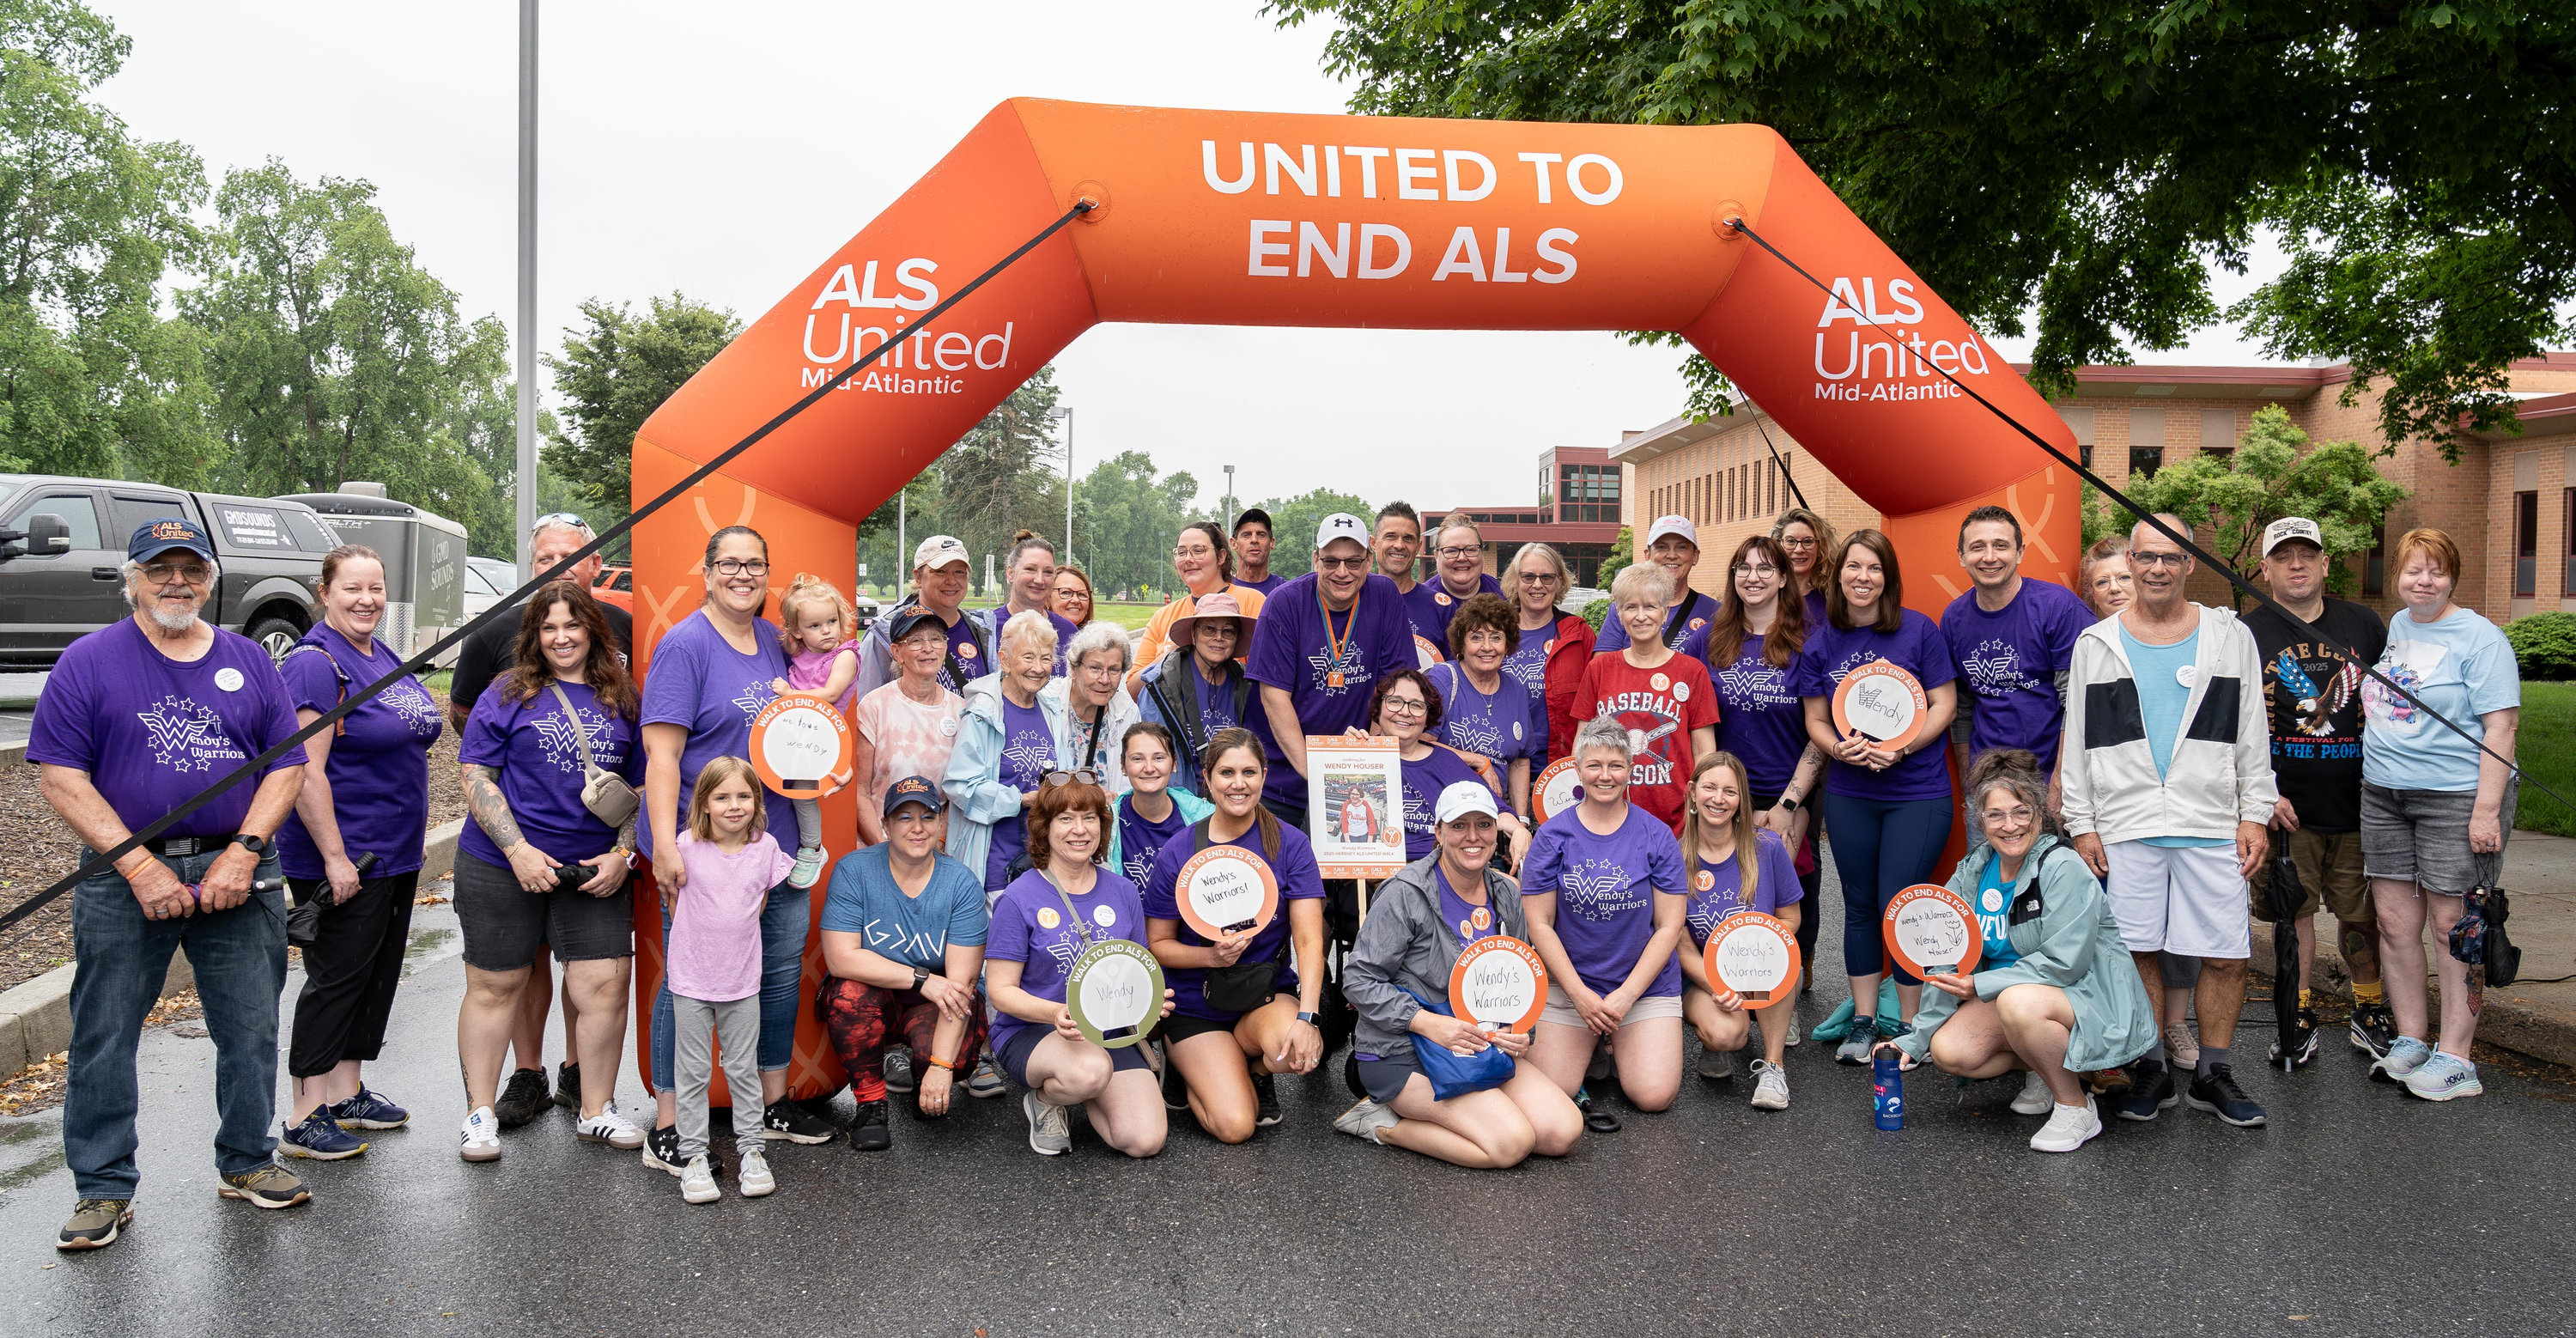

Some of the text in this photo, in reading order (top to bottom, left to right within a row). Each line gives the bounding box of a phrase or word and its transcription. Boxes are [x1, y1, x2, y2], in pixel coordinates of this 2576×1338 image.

[1202, 140, 1624, 205] UNITED TO
[1249, 219, 1580, 284] END ALS
[811, 258, 939, 311] ALS
[1817, 277, 1924, 327] ALS
[803, 313, 1013, 371] United
[1814, 329, 1990, 380] United
[1814, 379, 1962, 402] Mid-Atlantic
[224, 510, 276, 527] GMDSOUNDS
[161, 529, 195, 538] United
[2273, 530, 2287, 540] ROCK
[431, 562, 454, 590] SOUNDS
[1424, 642, 1437, 656] FOR
[2263, 643, 2312, 674] THE
[2302, 662, 2329, 672] 2025
[1753, 693, 1797, 704] Warriors
[1850, 666, 1924, 710] WALK TO END ALS FOR
[757, 698, 847, 733] WALK TO END ALS FOR
[1597, 691, 1681, 723] BASEBALL
[1859, 683, 1905, 728] Wendy
[191, 747, 246, 759] Warriors
[576, 751, 623, 763] Wrriors
[2285, 745, 2315, 758] THE
[1535, 760, 1577, 795] WALK TO END
[1347, 811, 1367, 821] Phillies
[1179, 848, 1263, 888] WALK TO END ALS FOR
[1201, 872, 1236, 887] Wendy's
[1202, 883, 1249, 904] Warriors!
[1598, 899, 1647, 910] Warriors
[1886, 899, 1904, 921] WALK
[1901, 892, 1913, 902] TO
[1935, 891, 1952, 903] ALS
[1952, 900, 1970, 917] FOR
[1924, 909, 1954, 921] Warriors
[1710, 923, 1732, 946] WALK
[1731, 917, 1744, 927] TO
[1765, 919, 1781, 931] ALS
[1779, 929, 1795, 947] FOR
[1913, 935, 1939, 949] Wendy
[1459, 940, 1543, 978] WALK TO END ALS FOR
[1726, 941, 1775, 962] Wendy's
[1072, 944, 1157, 983] WALK TO END ALS FOR
[1724, 964, 1771, 977] Warriors
[1474, 964, 1520, 988] Wendy's
[1096, 982, 1133, 1008] Wendy
[1473, 990, 1521, 1009] Warriors
[2444, 1072, 2465, 1086] HOKA
